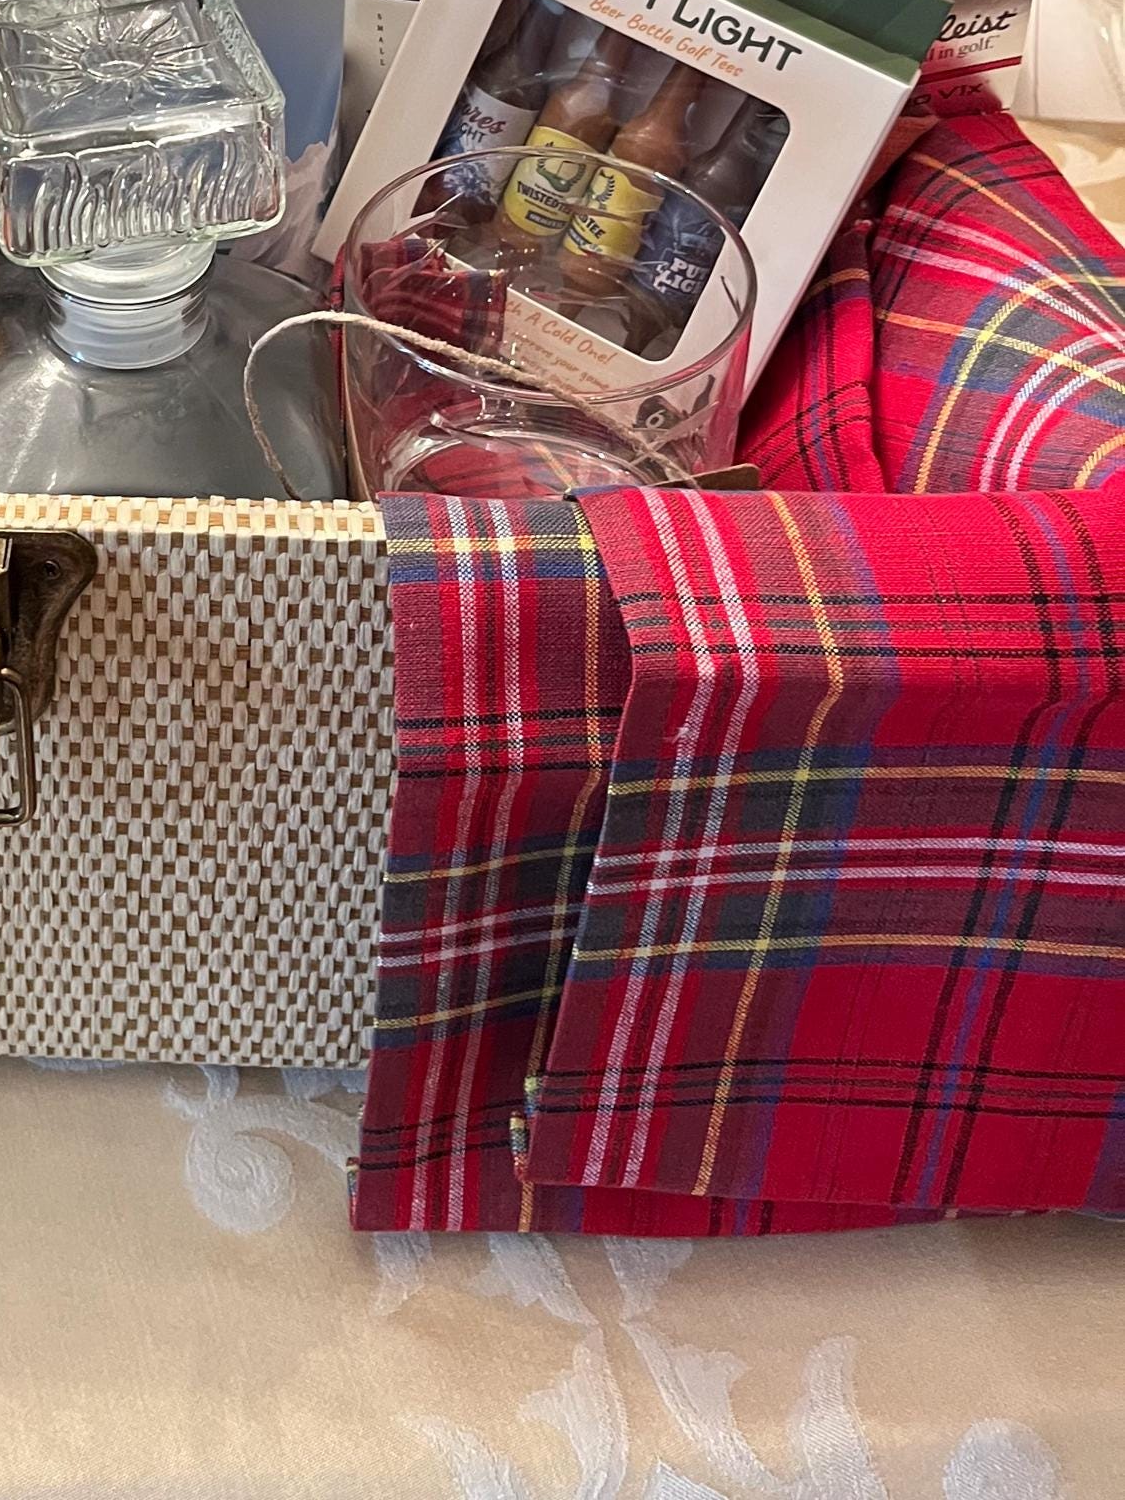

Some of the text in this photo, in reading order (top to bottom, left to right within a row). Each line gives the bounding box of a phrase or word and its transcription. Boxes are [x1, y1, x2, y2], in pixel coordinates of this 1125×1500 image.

[376, 12, 386, 67] SMALL
[935, 10, 1018, 43] leist
[627, 13, 674, 46] Bottle
[675, 36, 711, 62] Golf
[711, 52, 744, 78] Tees
[461, 122, 486, 144] GHT
[517, 180, 560, 209] TWISTED
[586, 216, 607, 240] TEE
[526, 312, 540, 327] A
[542, 320, 573, 345] Cold
[577, 339, 619, 366] One!
[644, 408, 666, 430] 6
